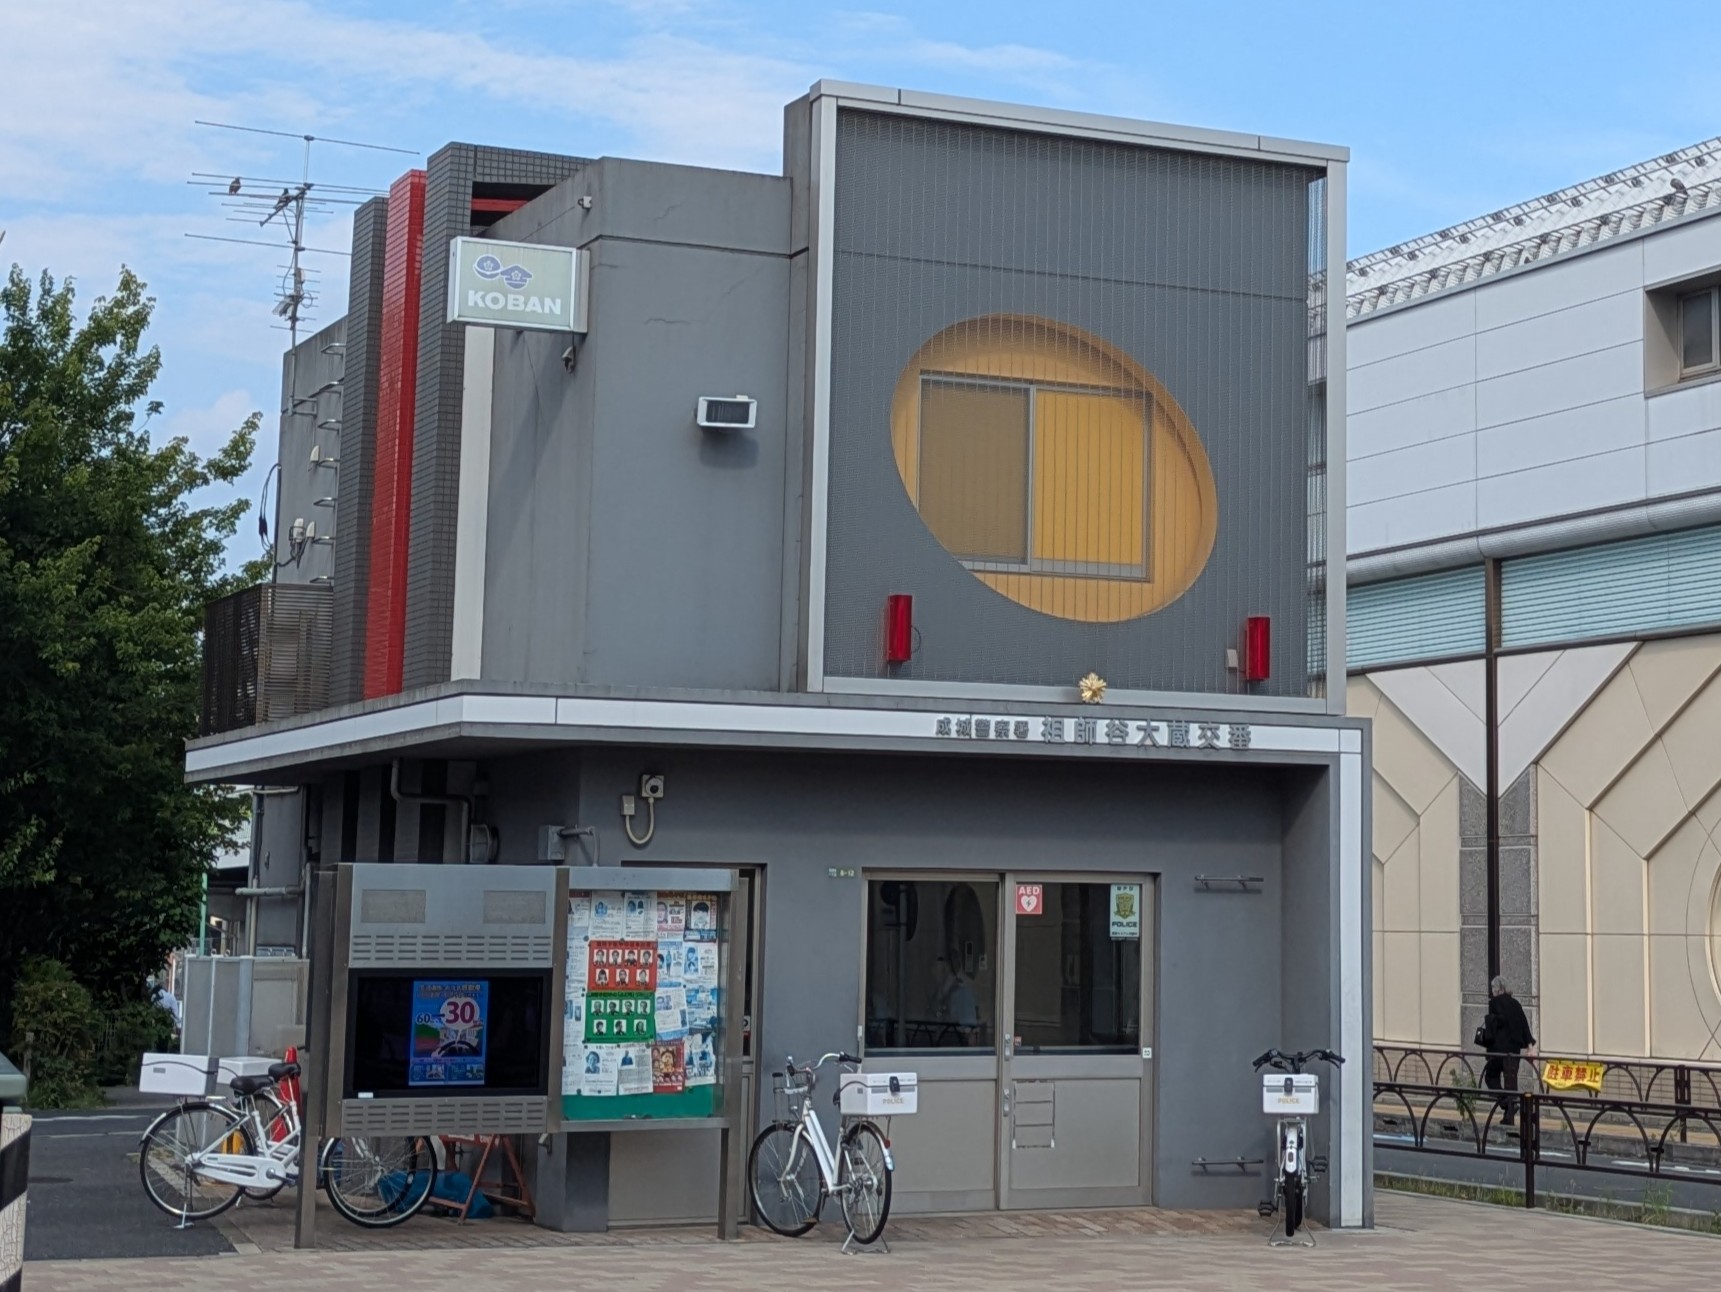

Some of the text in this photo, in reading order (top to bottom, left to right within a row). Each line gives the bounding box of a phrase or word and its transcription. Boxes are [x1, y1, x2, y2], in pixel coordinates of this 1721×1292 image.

[467, 290, 561, 314] KOBAN
[935, 716, 1252, 750] 成城警察署 祖師谷大蔵交番
[1018, 886, 1041, 896] AED
[416, 1001, 475, 1024] 60 30
[1546, 1064, 1601, 1084] 駐車禁止
[882, 1097, 905, 1106] POLICE
[1277, 1097, 1301, 1105] POLICE
